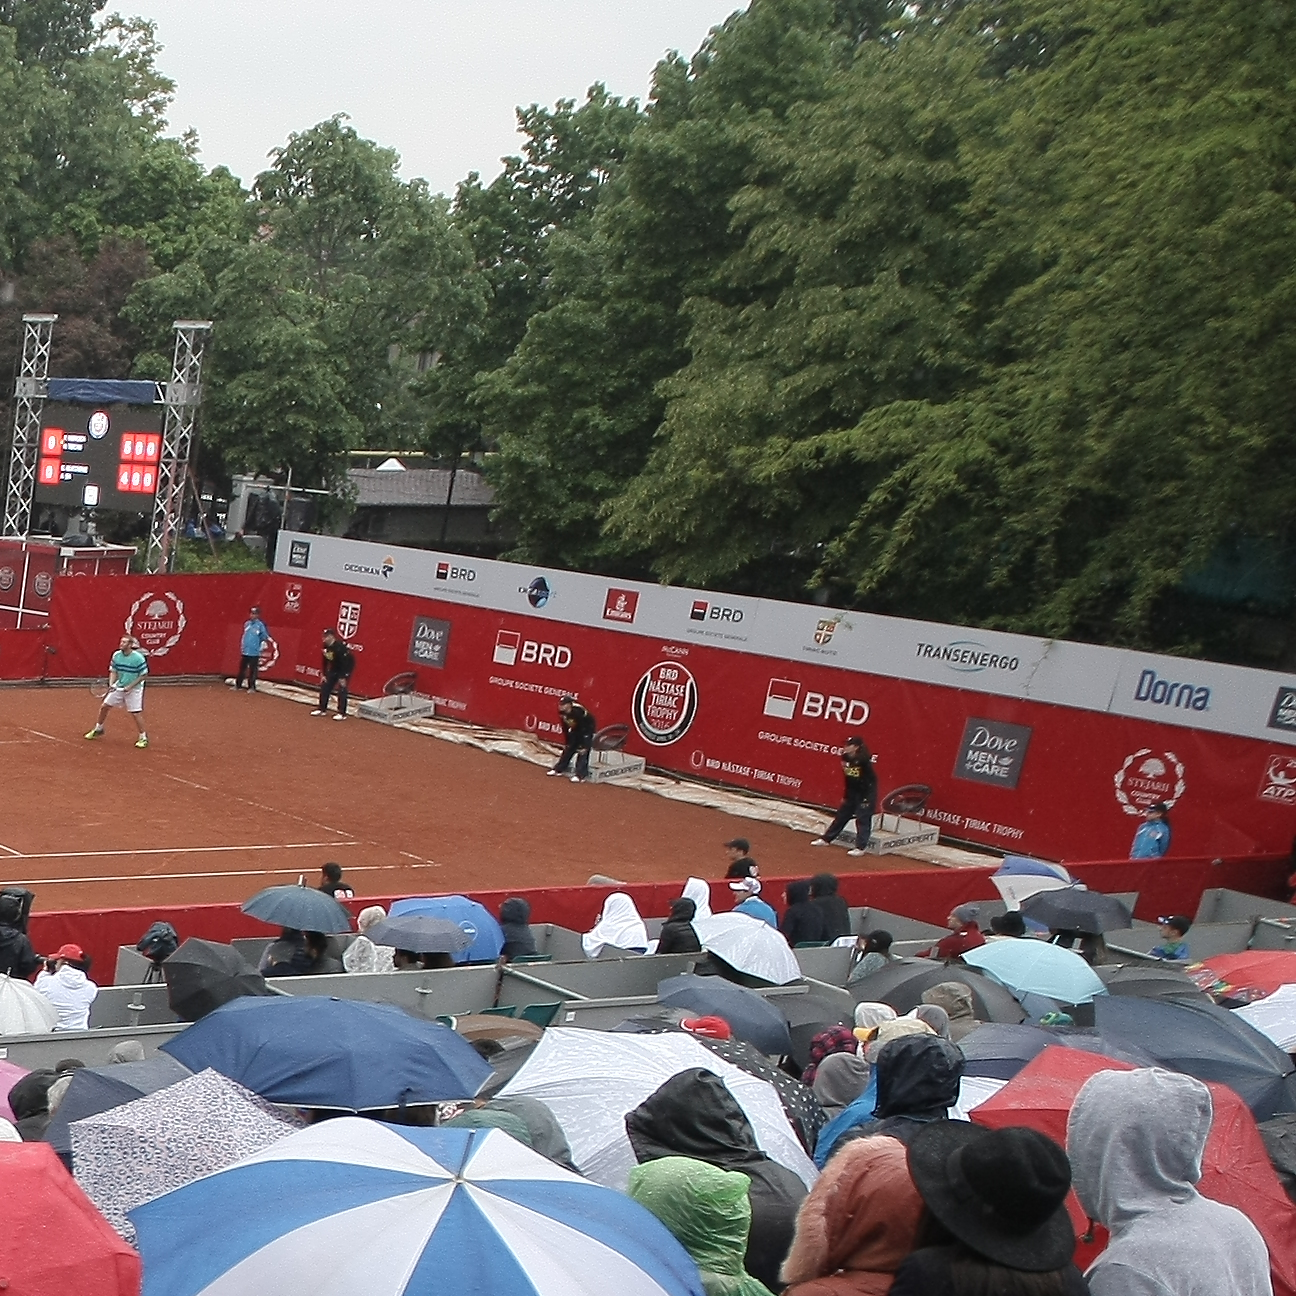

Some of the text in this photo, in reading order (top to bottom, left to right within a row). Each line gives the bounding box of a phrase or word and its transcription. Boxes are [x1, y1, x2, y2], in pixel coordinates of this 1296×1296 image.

[451, 567, 476, 582] BRD
[710, 606, 743, 623] BRD
[416, 622, 444, 642] Dove
[520, 640, 572, 669] BRD
[915, 642, 1020, 671] TRANSENERGO
[659, 667, 679, 680] BRD
[489, 675, 514, 689] GROUPE
[514, 681, 543, 694] SOCIETE
[1134, 668, 1211, 712] Dorna
[647, 705, 679, 721] TROPHY
[802, 691, 871, 726] BRD
[757, 731, 829, 754] GROUPE SOCIETE
[969, 726, 1018, 753] Dove
[966, 750, 998, 764] MEN
[705, 758, 720, 769] BRD
[776, 773, 803, 789] TROPHY
[964, 761, 1010, 778] +CARE
[1263, 786, 1296, 799] ATP
[992, 823, 1025, 840] TROPHY
[882, 833, 937, 850] MOBEXPERT
